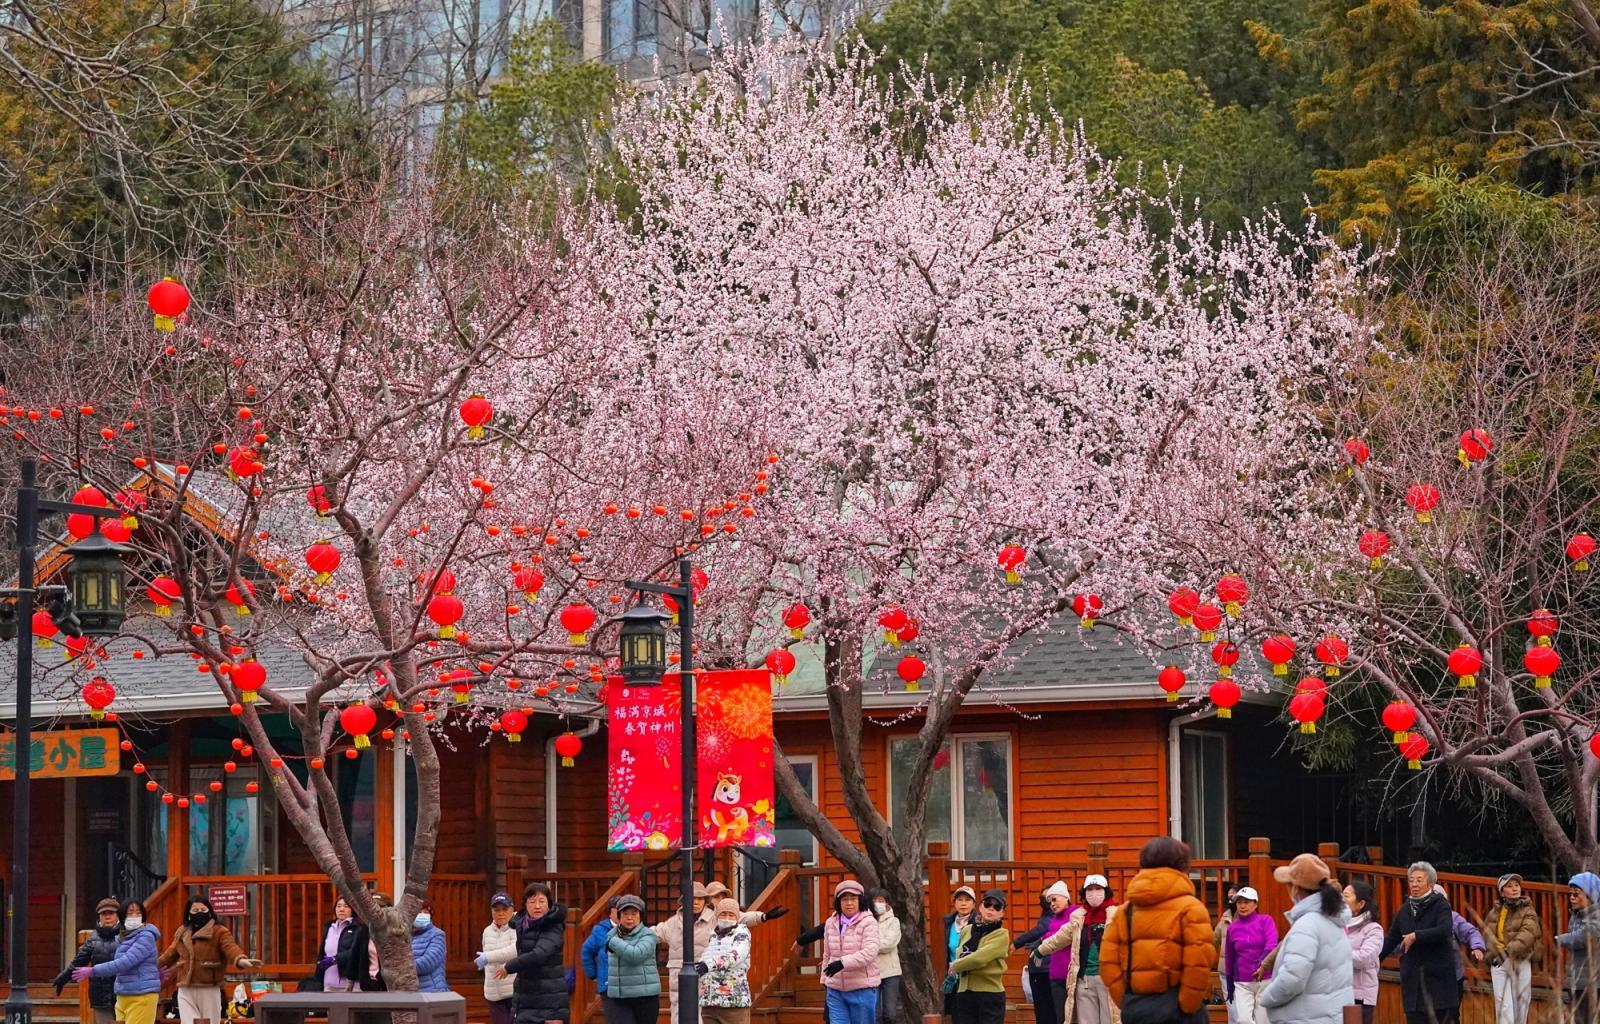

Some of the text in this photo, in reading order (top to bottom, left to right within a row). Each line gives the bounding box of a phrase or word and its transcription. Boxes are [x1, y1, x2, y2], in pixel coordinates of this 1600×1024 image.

[614, 704, 667, 720] 福满京城
[624, 720, 675, 736] 春贺神州
